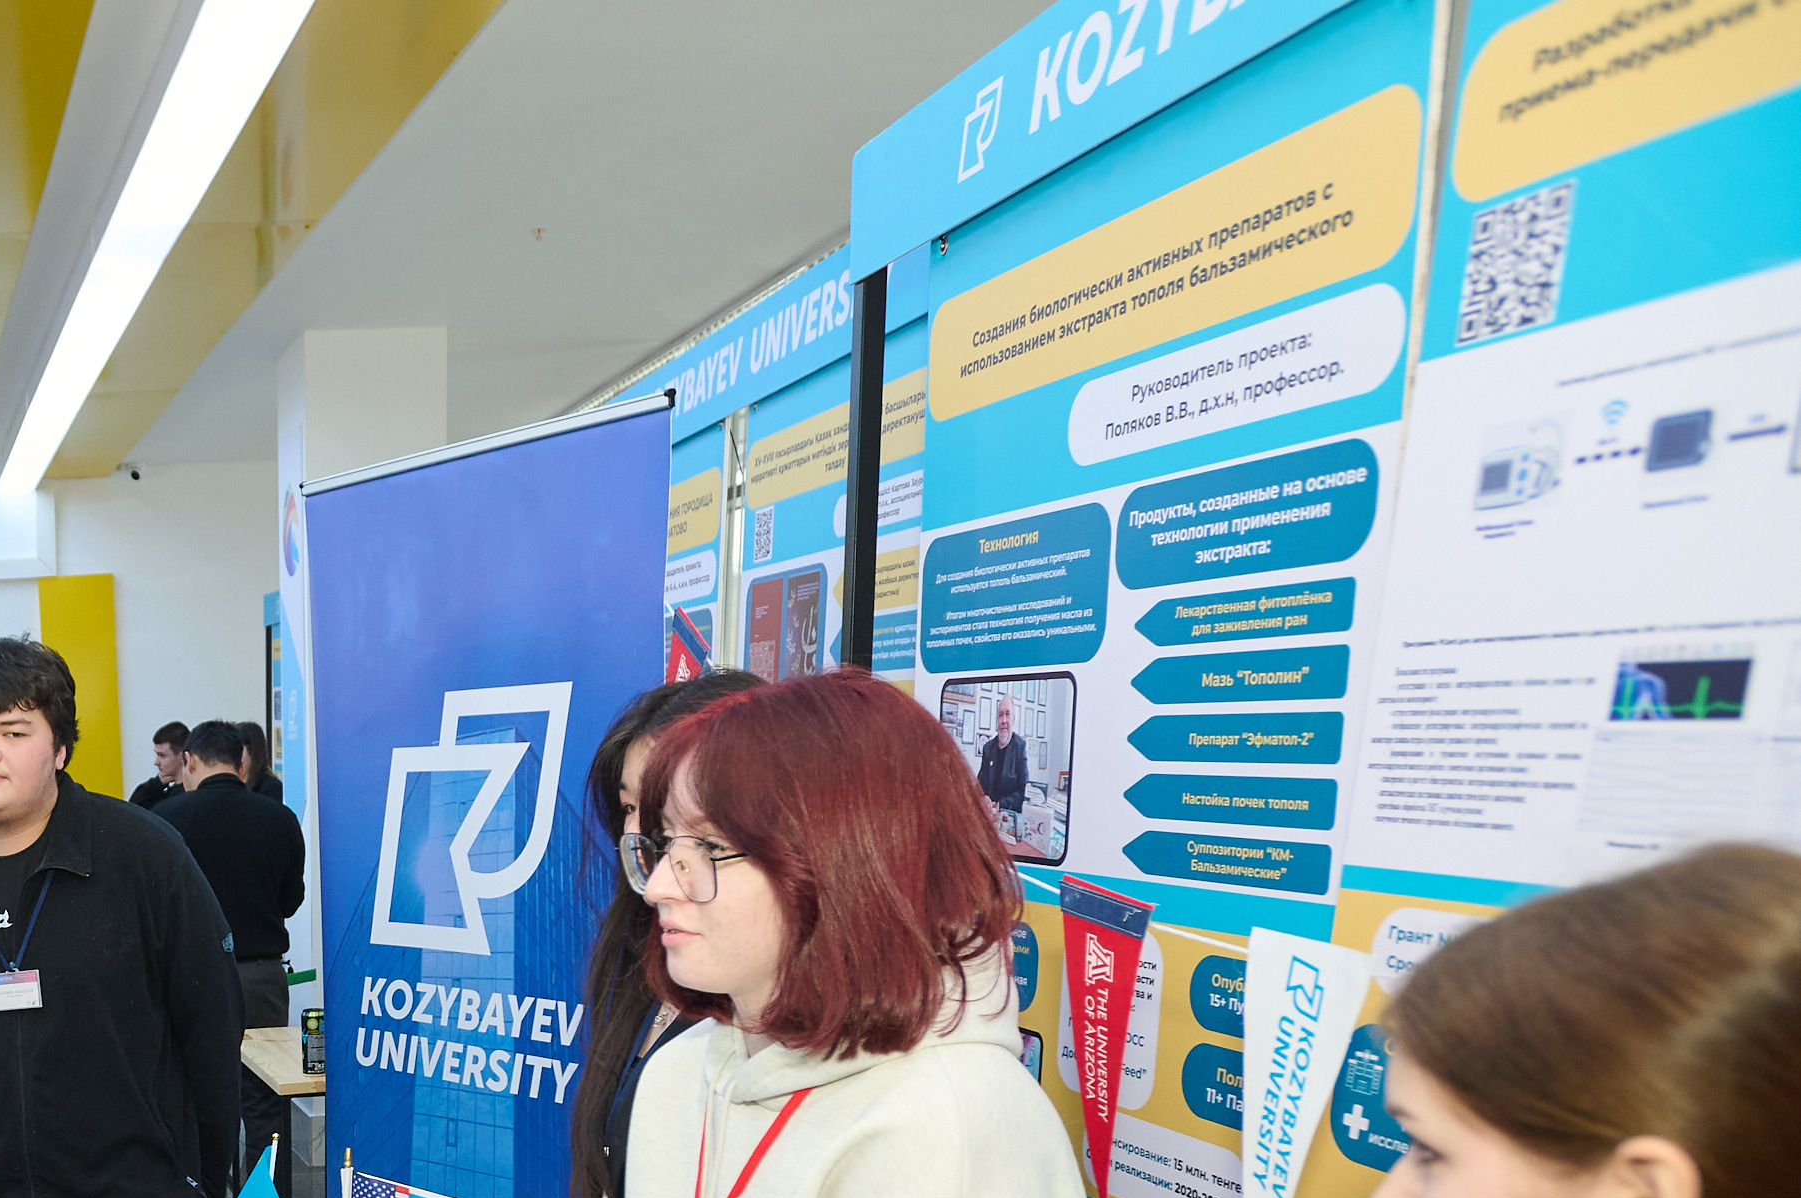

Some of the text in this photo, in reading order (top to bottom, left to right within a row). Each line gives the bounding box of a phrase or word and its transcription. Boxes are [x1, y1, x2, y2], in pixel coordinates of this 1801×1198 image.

[972, 182, 1334, 348] Создания биологически активных препаратов с
[960, 209, 1355, 379] использованием экстракта тополя бальзамического
[1131, 332, 1313, 404] Руководитель проекта:
[1105, 359, 1345, 440] Поляков В.В., д.х.н, профессор.
[1128, 466, 1368, 529] Продукты, созданные на основе
[1150, 501, 1332, 547] технологии применения
[978, 530, 1040, 554] Технология
[1194, 539, 1272, 565] экстракта:
[935, 547, 1091, 585] Для создания биологически активных препаратов
[950, 565, 1068, 595] используется тополь бальзамический.
[945, 595, 1072, 621] Итогом многочисленных исследований и
[1174, 590, 1333, 620] Лекарственная фитоплёнка
[929, 607, 1094, 637] экспериментов стала технология получения масла из
[974, 631, 1001, 644] свойства
[1001, 630, 1013, 641] его
[1012, 627, 1046, 640] оказались
[1045, 622, 1097, 639] уникальными.
[1191, 614, 1308, 637] для заживления ран
[1201, 671, 1234, 688] Мазь
[1188, 732, 1241, 748] Препарат
[1181, 791, 1310, 811] Настойка почек тополя
[1186, 839, 1264, 861] Суппозитории
[1387, 924, 1433, 947] Грант
[360, 976, 585, 1047] KOZYBAYEV
[1209, 993, 1227, 1008] 15+
[1084, 995, 1097, 1100] OF ARIZONA
[1097, 988, 1109, 1123] THE UNIVERSITY
[354, 1027, 579, 1105] UNIVERSITY
[1206, 1087, 1224, 1104] 11+
[1253, 1015, 1295, 1191] UNIVERSITY
[1114, 1160, 1173, 1191] реализации:
[1173, 1157, 1183, 1172] 15
[1185, 1164, 1209, 1182] млн.
